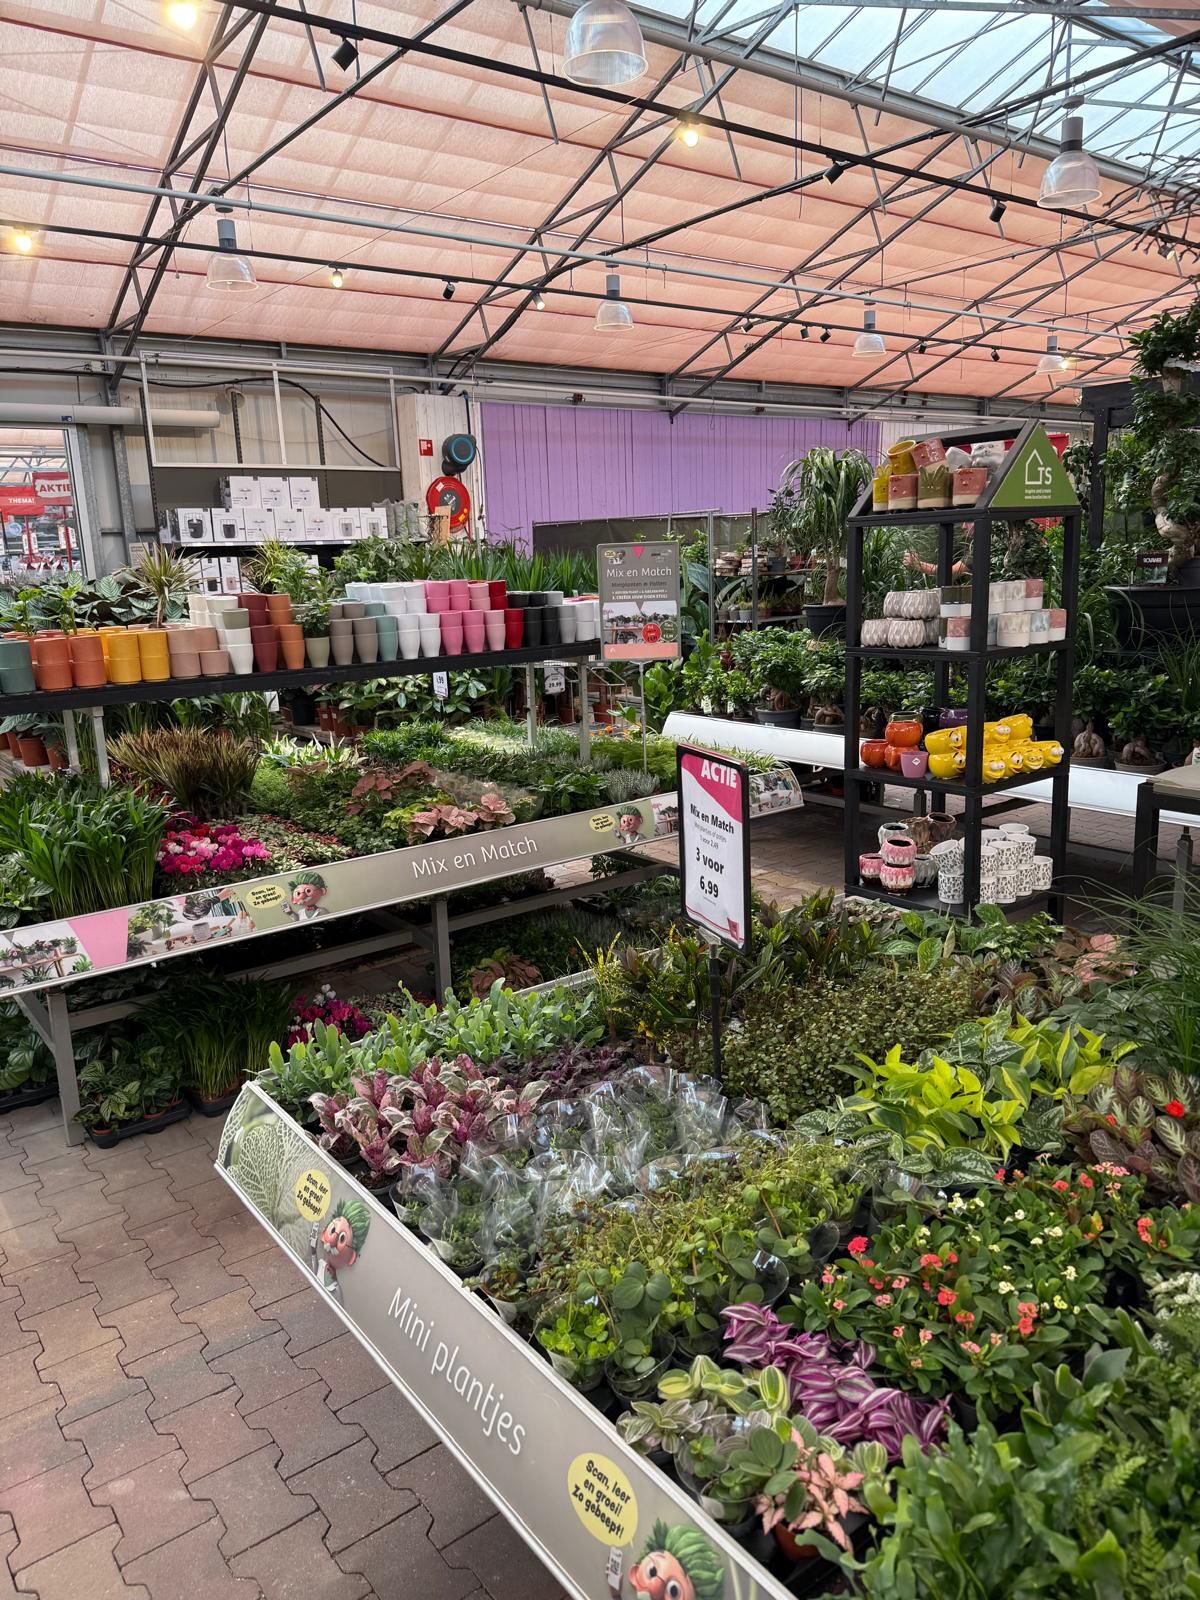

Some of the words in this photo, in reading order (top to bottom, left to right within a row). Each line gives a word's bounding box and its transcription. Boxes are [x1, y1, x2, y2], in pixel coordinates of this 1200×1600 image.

[606, 569, 624, 577] Mix
[642, 568, 672, 576] Match
[701, 759, 737, 788] ACTIE
[690, 803, 700, 817] Mix
[701, 813, 709, 823] en
[711, 815, 734, 834] Match
[412, 857, 448, 878] Mix
[454, 852, 476, 869] en
[480, 836, 538, 862] Match
[696, 847, 700, 861] 3
[702, 855, 724, 874] voor
[388, 1287, 435, 1352] Mini
[430, 1342, 526, 1455] plantjes
[584, 1479, 596, 1494] en
[596, 1490, 623, 1517] groei!
[586, 1460, 609, 1490] Scan,
[612, 1481, 631, 1504] leer
[572, 1483, 584, 1502] Zo
[585, 1499, 624, 1539] gebeept!
